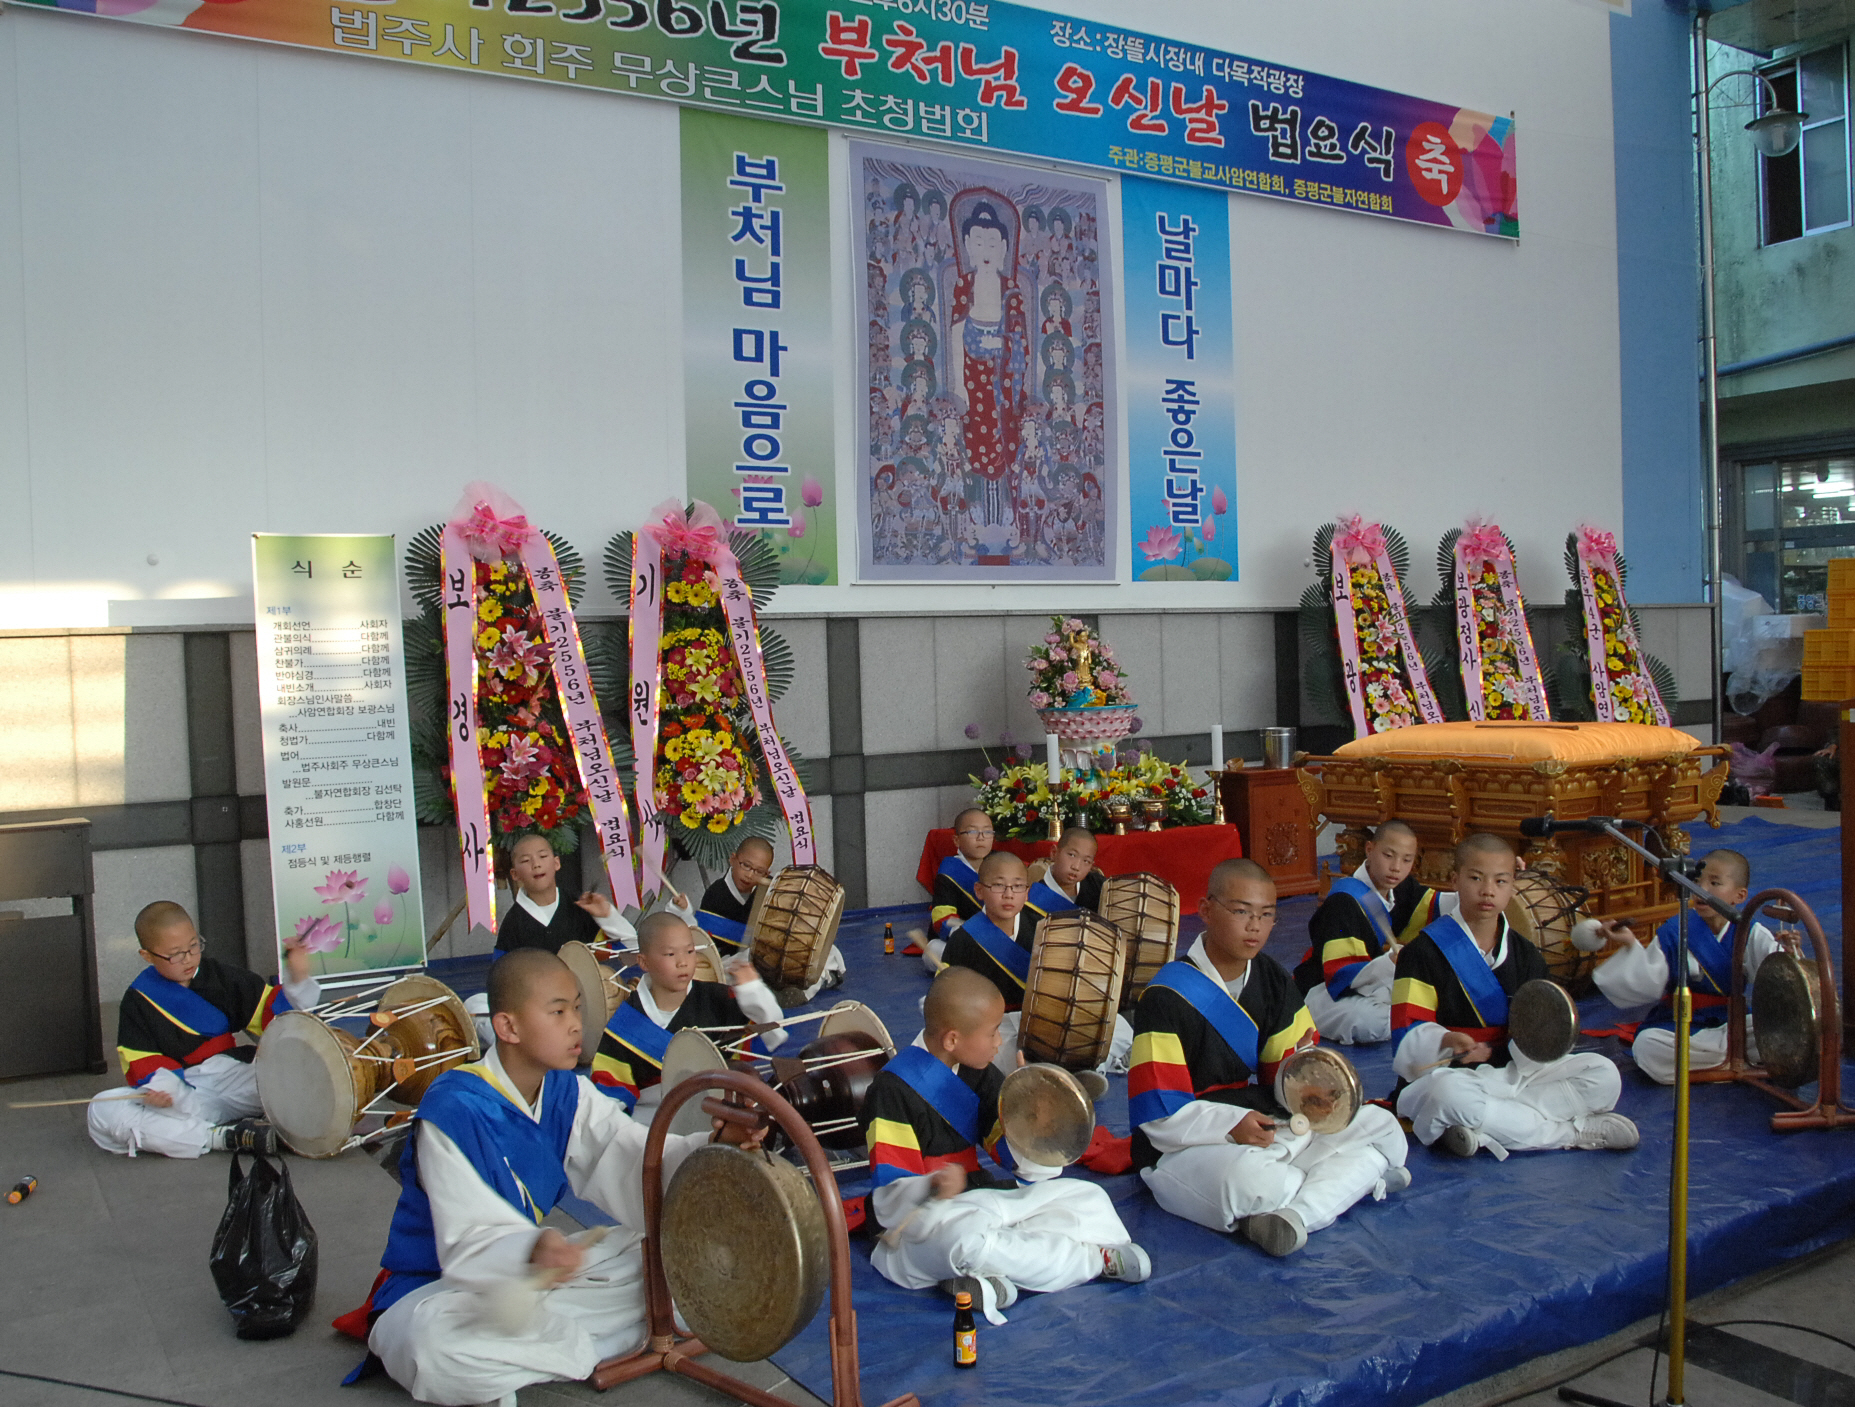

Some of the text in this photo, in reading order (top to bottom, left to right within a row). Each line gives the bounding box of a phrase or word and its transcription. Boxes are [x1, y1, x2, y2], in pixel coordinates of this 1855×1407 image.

[330, 6, 989, 143] 법주사 회주 무상큰스님 초청법회
[1212, 58, 1304, 98] 다목적광장
[818, 11, 1027, 110] 부처님
[1053, 62, 1228, 148] 오신날
[1250, 100, 1395, 181] 법요식
[1416, 134, 1455, 195] 축
[1294, 178, 1392, 213] 증평군불자연합회
[727, 151, 792, 529] 부처님 마음으로
[1156, 211, 1205, 527] 날마다 좋은날
[266, 606, 291, 615] 제1부
[273, 619, 388, 631] 개회선언 사회자
[274, 631, 389, 643] 관불의식 다함께
[274, 643, 390, 656] 삼귀의례 다함께
[275, 656, 390, 668] 찬불가 다함께
[275, 668, 391, 681] 반야심경 다함께
[277, 680, 392, 693] 내빈소개 사회자
[1593, 662, 1608, 722] 사암연
[277, 694, 352, 705] 회장스님인사말씀
[1415, 681, 1440, 723] 부처님오
[298, 704, 395, 717] 사암연합회장 보광스님
[279, 718, 395, 733] 축사 내빈
[279, 731, 395, 746] 청법가 다함께
[281, 751, 300, 761] 법어
[301, 757, 399, 772] 법주사회주 무상큰스님
[282, 777, 311, 789] 발원문
[575, 719, 615, 803] 부처님오신날
[602, 816, 627, 859] 법요식
[759, 722, 797, 798] 부처님오신날
[790, 811, 808, 849] 법요식
[314, 784, 402, 799] 불자연합회장 김선탁
[284, 799, 402, 816] 축가 합창단
[376, 811, 404, 822] 다함께
[282, 843, 306, 854] 제2부
[288, 853, 371, 869] 점등식 및 제등행렬
